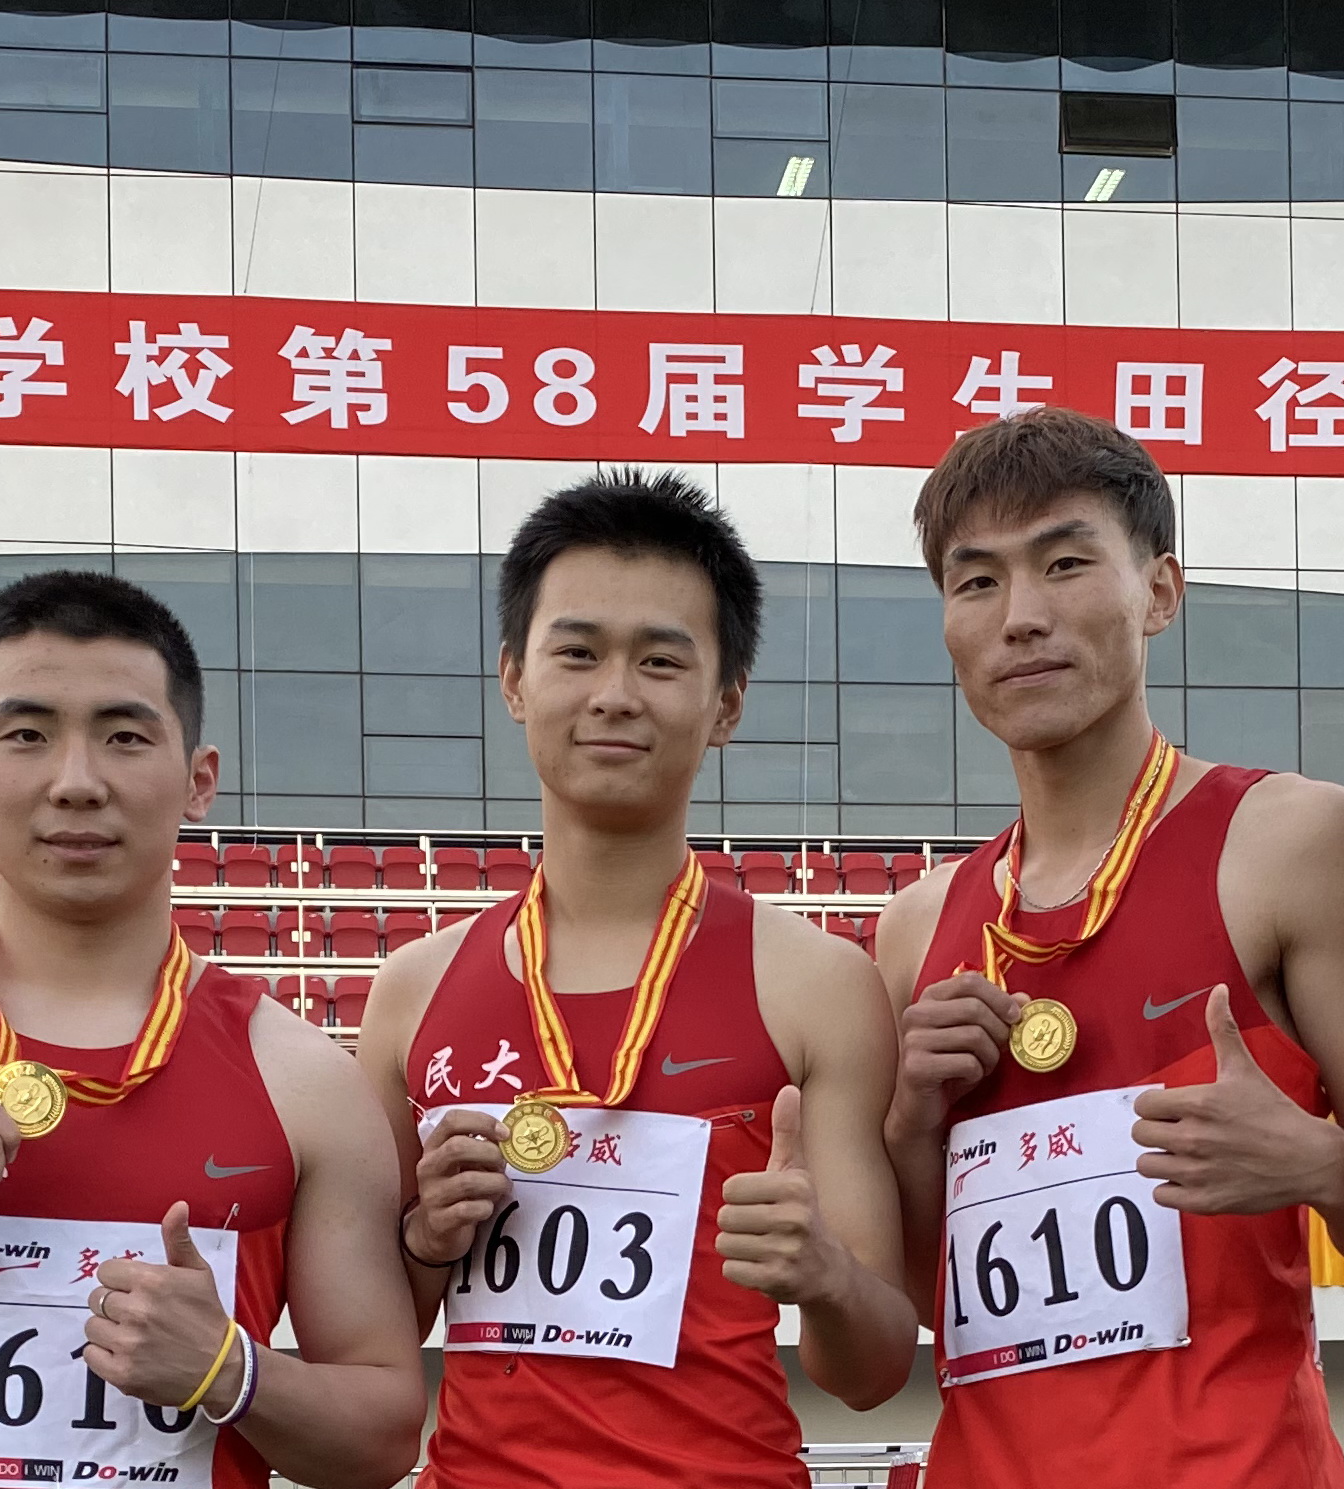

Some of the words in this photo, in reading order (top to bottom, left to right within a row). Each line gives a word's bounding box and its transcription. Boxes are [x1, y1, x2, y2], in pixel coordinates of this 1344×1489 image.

[425, 1039, 522, 1098] 民大
[1017, 1123, 1083, 1171] 多威
[948, 1195, 1149, 1327] 1610
[486, 1327, 500, 1339] DO
[512, 1327, 534, 1341] WIN
[541, 1324, 633, 1348] Do-win
[1054, 1320, 1144, 1354] Do-win
[1000, 1350, 1016, 1363] DO
[1025, 1345, 1045, 1358] WIN
[34, 1464, 61, 1478] WIN
[72, 1461, 179, 1483] Do-win
